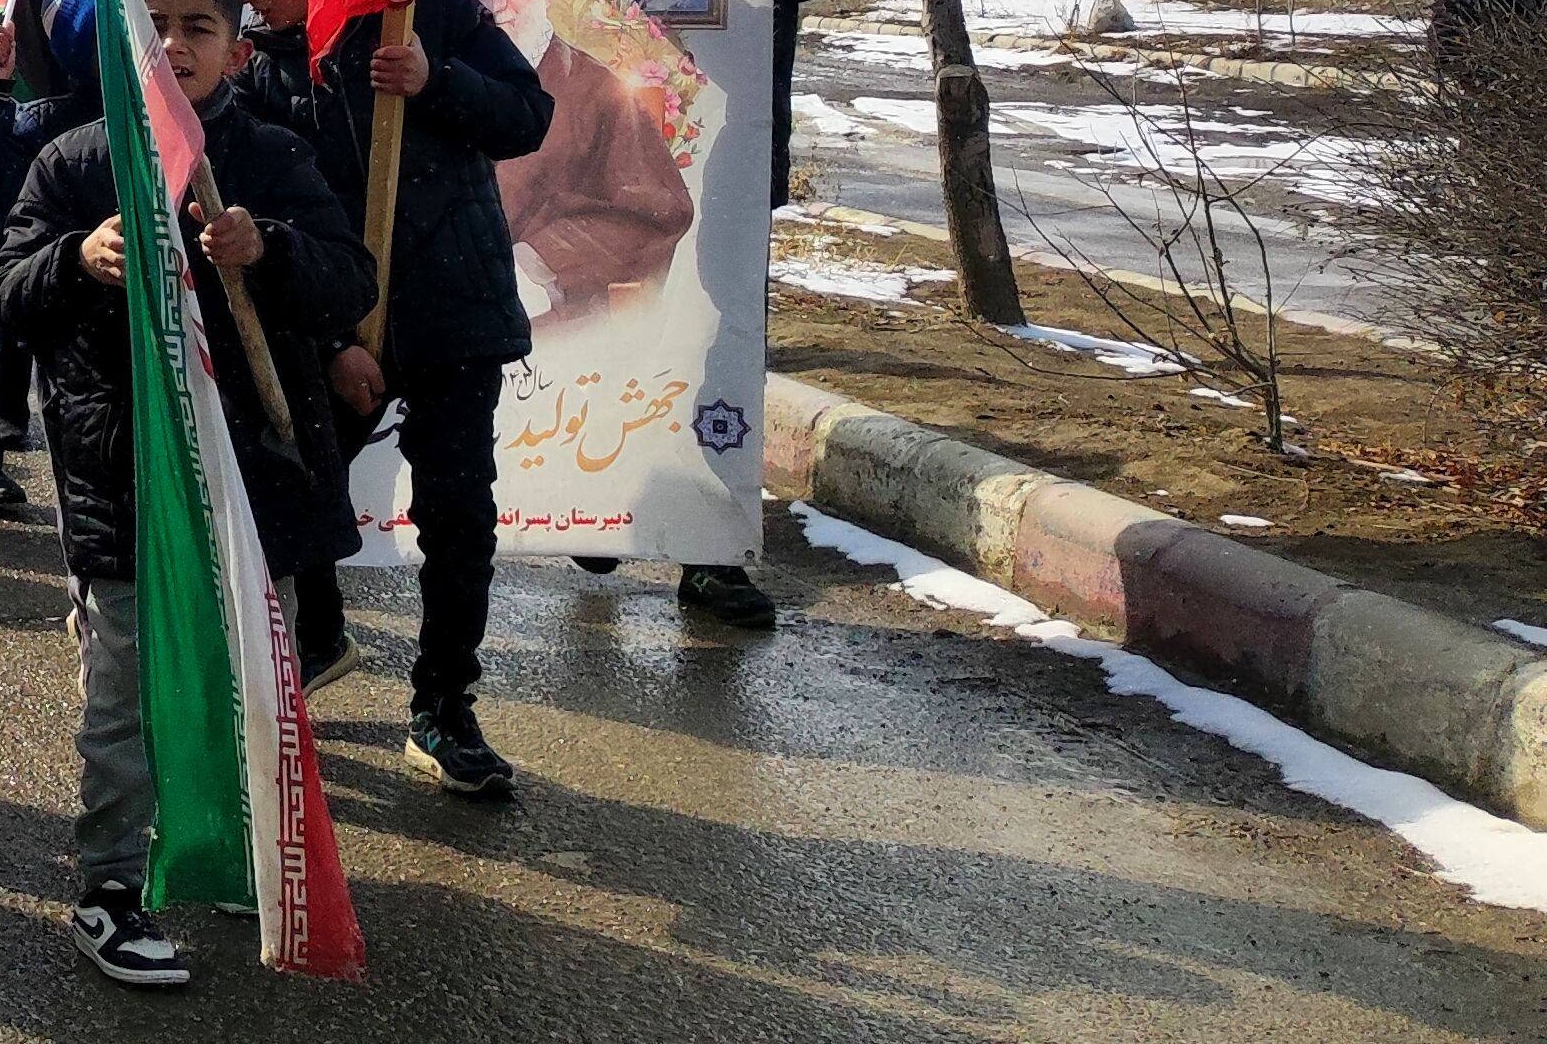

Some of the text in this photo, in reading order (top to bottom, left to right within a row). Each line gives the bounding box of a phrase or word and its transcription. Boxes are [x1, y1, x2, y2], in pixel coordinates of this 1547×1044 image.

[504, 371, 602, 470] تولید
[576, 368, 690, 473] جهش
[555, 507, 634, 533] دبیرستان
